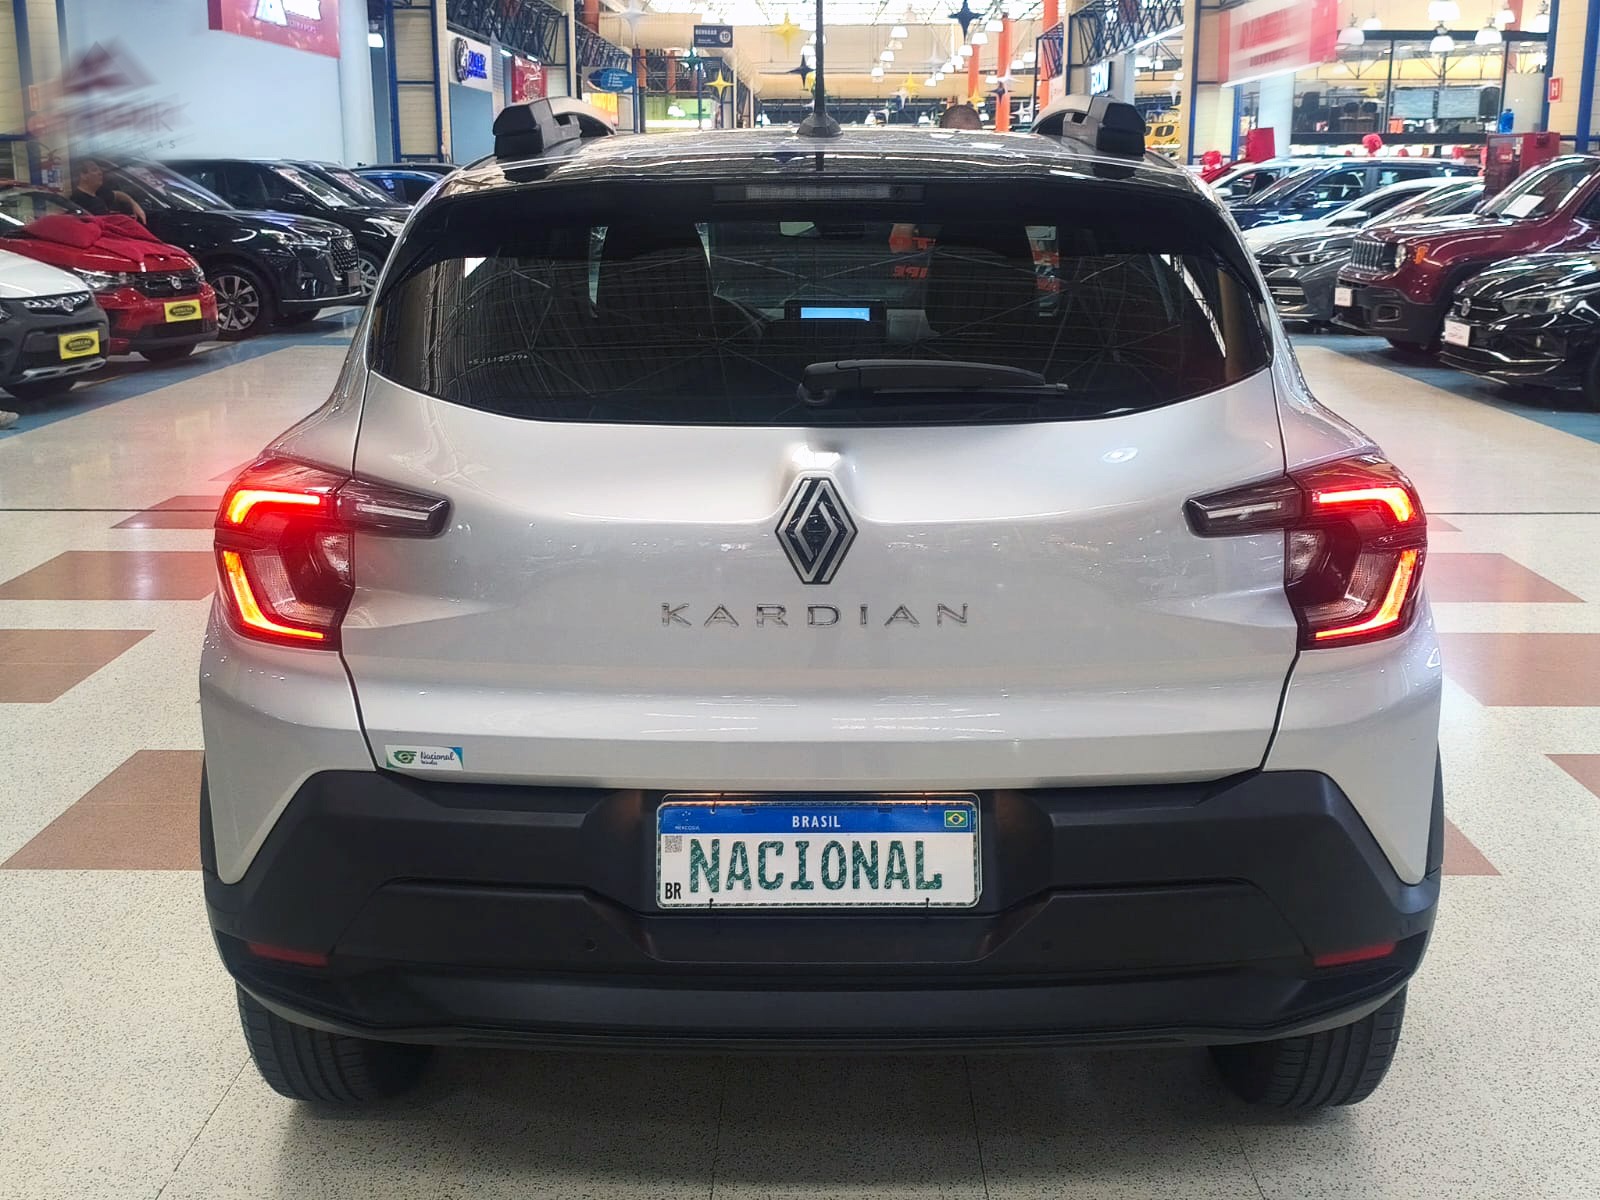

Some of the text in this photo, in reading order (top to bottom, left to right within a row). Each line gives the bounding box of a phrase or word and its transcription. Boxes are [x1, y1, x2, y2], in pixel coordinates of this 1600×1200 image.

[661, 602, 968, 626] KARDIAN
[420, 751, 455, 761] Nacional
[792, 815, 841, 828] BRASIL
[690, 838, 942, 893] NACIONAL
[664, 882, 682, 899] BR
